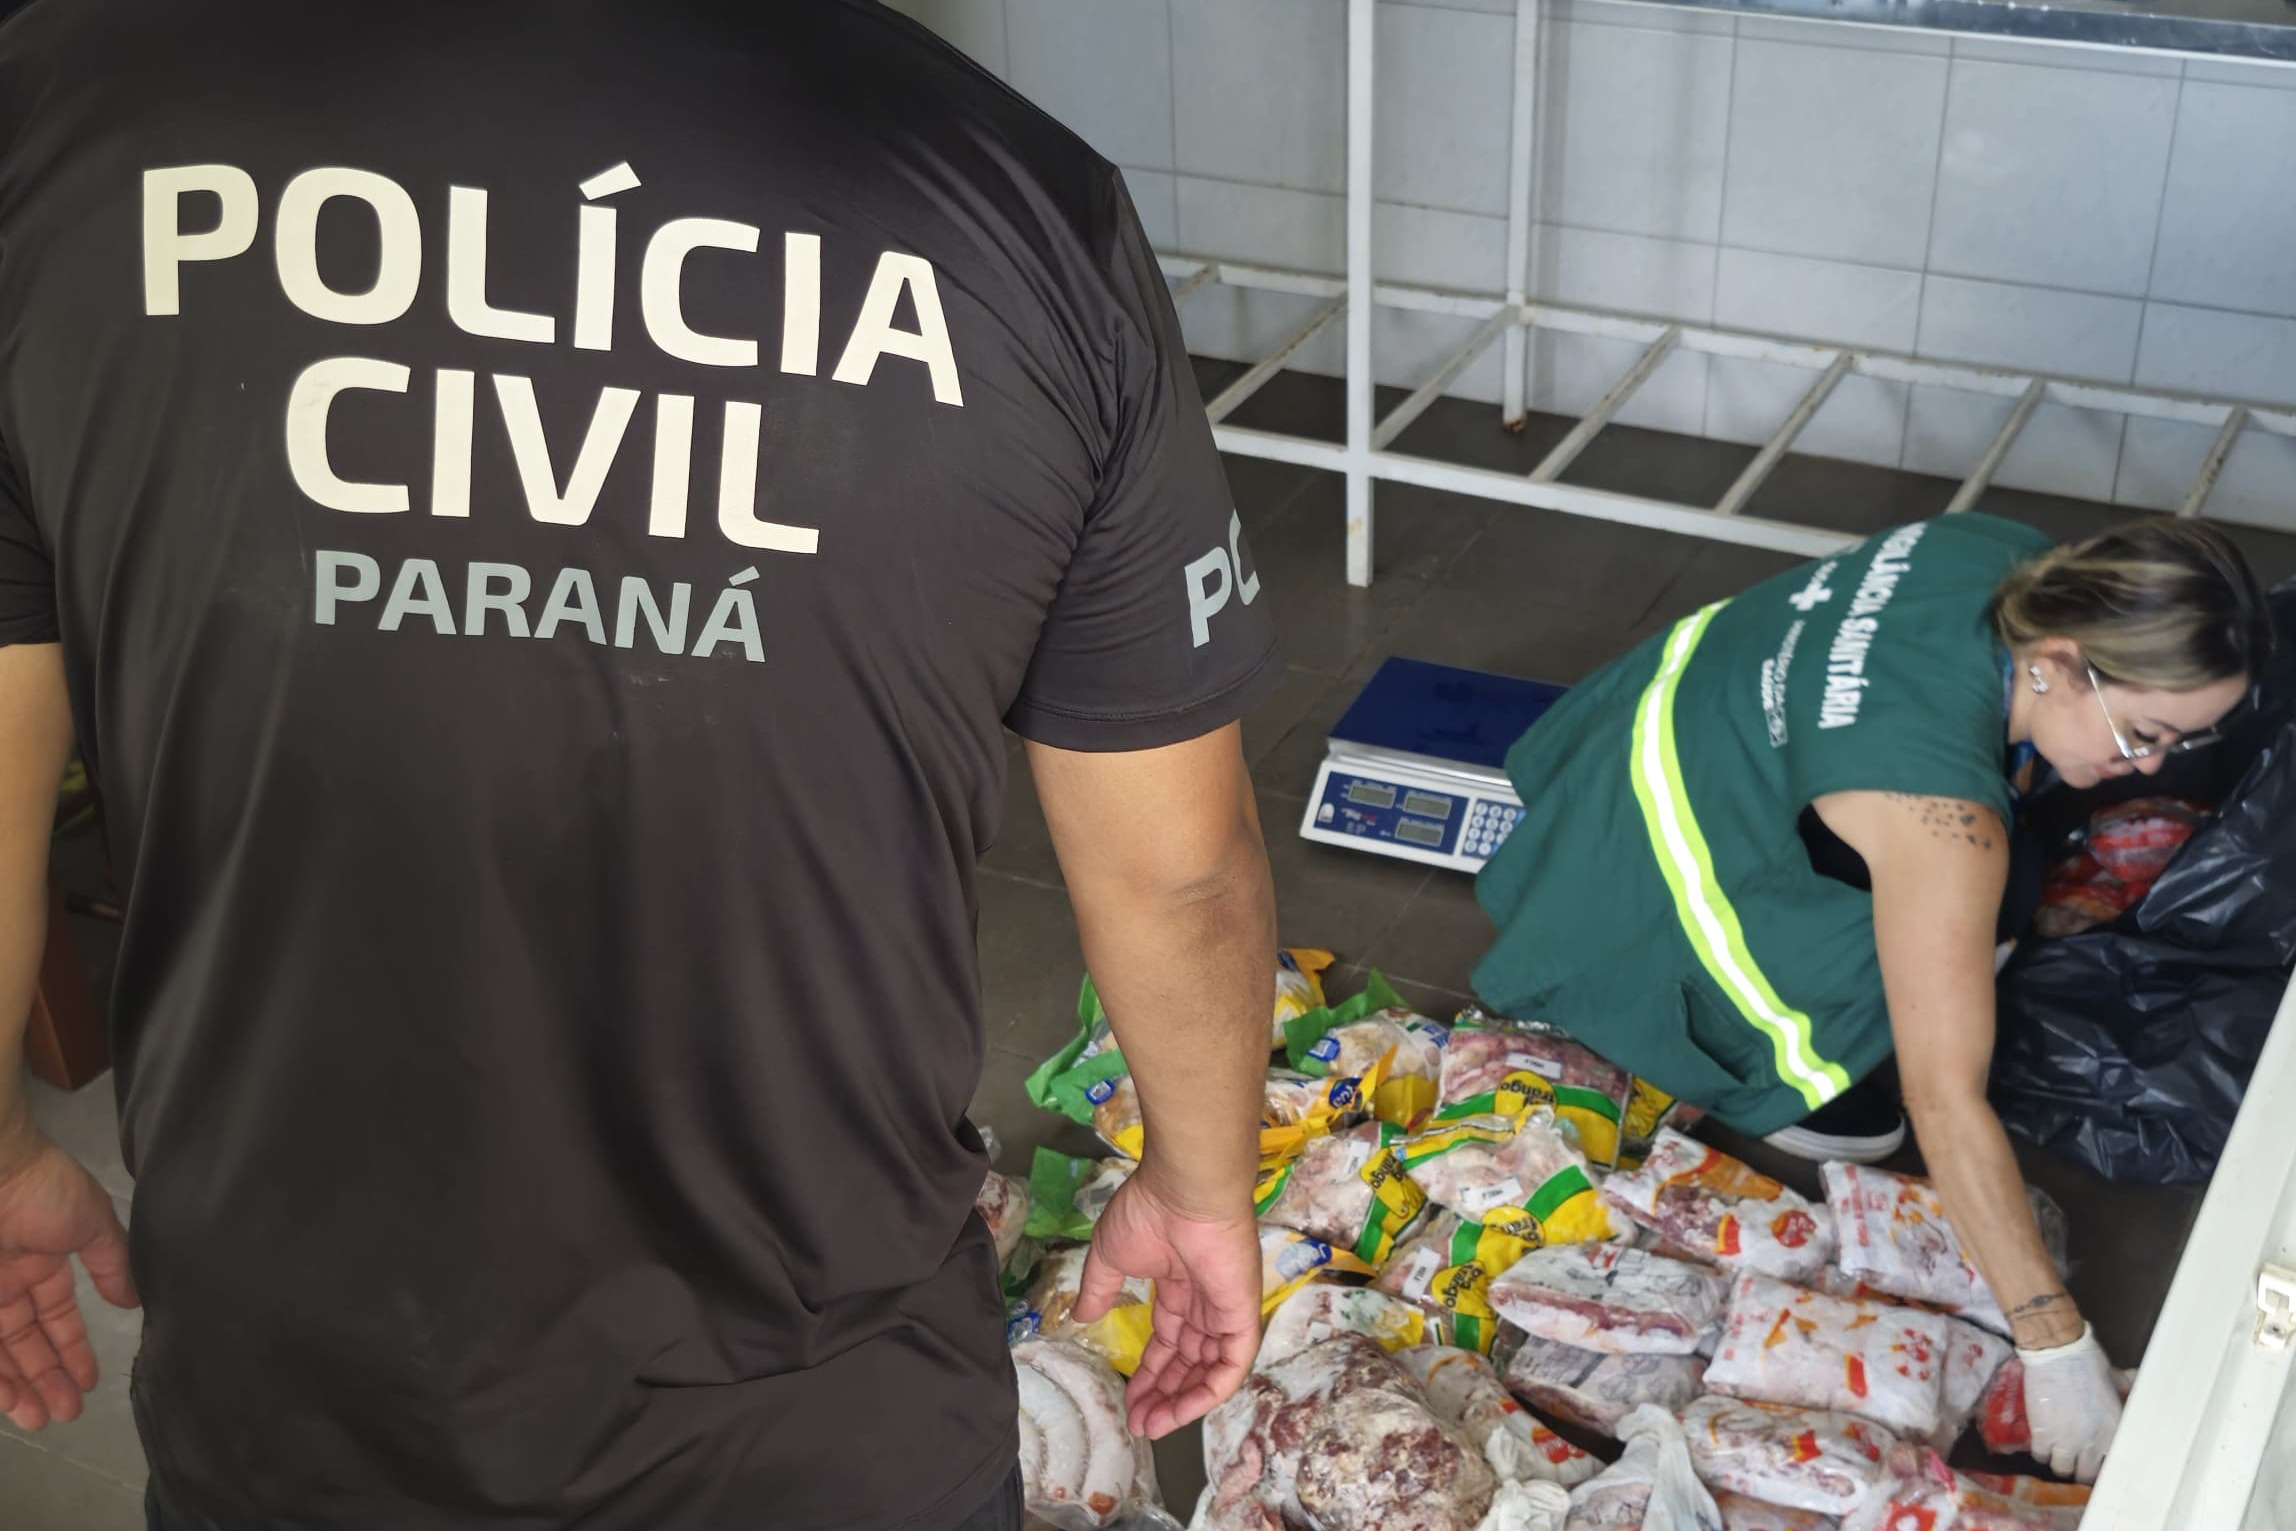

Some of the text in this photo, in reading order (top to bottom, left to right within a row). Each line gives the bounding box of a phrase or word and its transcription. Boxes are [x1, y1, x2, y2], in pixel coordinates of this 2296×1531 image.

[144, 162, 963, 407] POLÍCIA
[286, 357, 819, 554] CIVIL
[314, 550, 765, 662] PARANÁ
[1817, 617, 1878, 728] SANITÁRIA
[1372, 1155, 1397, 1189] rango
